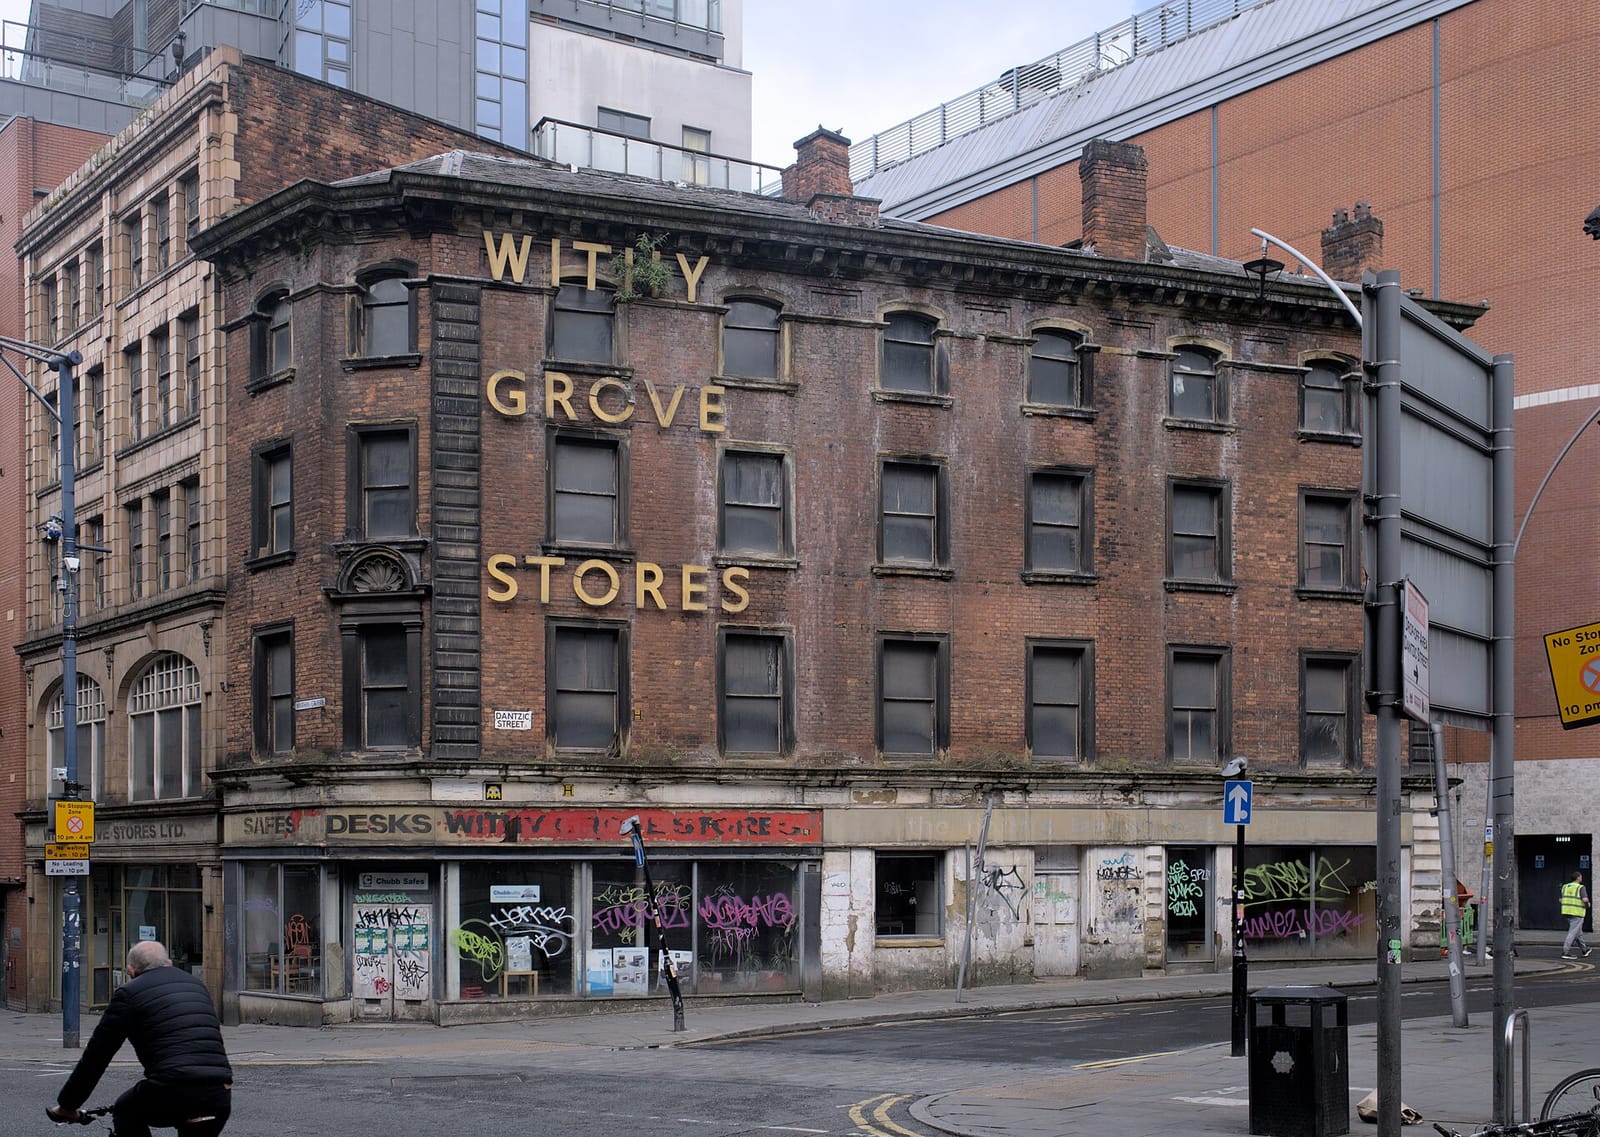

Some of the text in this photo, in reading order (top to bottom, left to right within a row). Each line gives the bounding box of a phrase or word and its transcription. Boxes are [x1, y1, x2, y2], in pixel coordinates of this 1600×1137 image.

[486, 369, 727, 433] GROVE
[487, 553, 751, 613] STORES
[1552, 637, 1571, 649] No
[495, 712, 530, 721] DANTZIC
[1564, 701, 1600, 716] 10 pm
[497, 720, 525, 729] STREET
[244, 815, 296, 835] SAFES
[326, 814, 432, 834] DESKS
[443, 810, 546, 834] WITY
[113, 824, 157, 840] STORES
[160, 823, 186, 838] LTD.
[375, 877, 425, 885] Chubb Safes
